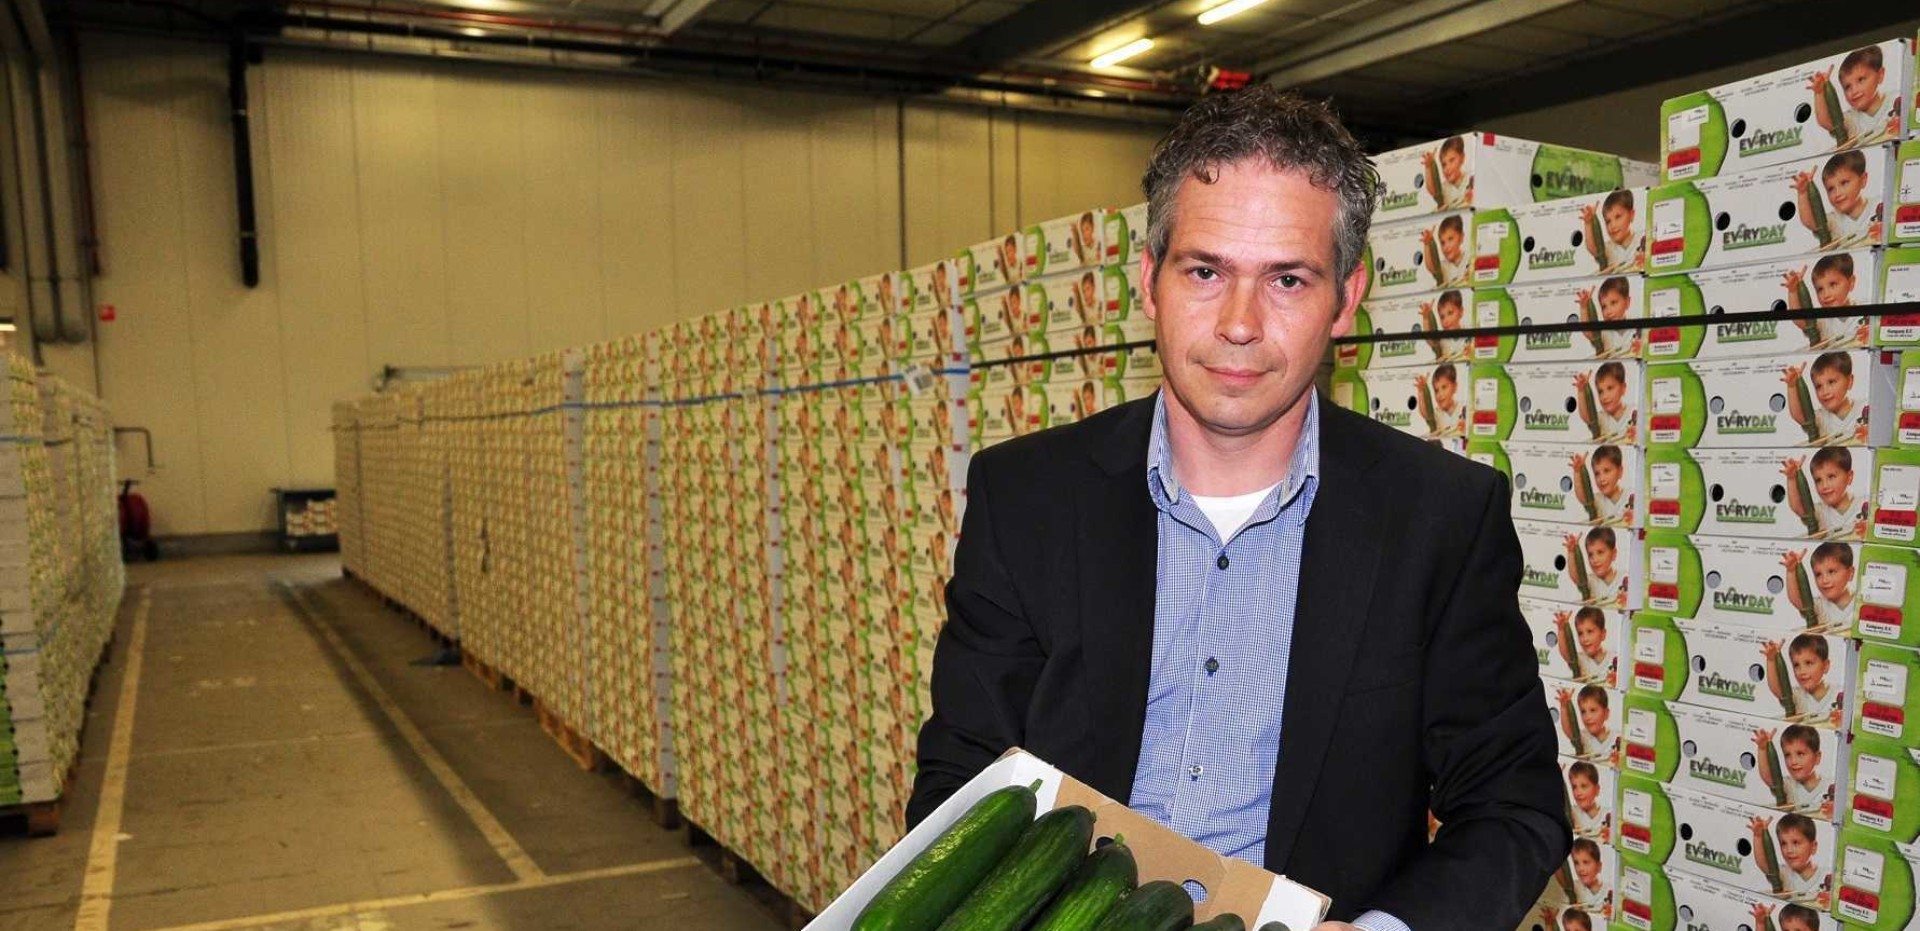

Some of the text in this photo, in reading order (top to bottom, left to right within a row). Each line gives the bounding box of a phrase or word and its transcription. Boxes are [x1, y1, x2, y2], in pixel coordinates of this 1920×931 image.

[1723, 223, 1787, 244] EVERYDAY
[1717, 409, 1778, 428] EVERYDAY
[1716, 498, 1777, 518] EVERYDAY
[1713, 586, 1775, 608] EVERYDAY
[1699, 672, 1756, 696] EVERYDAY
[1689, 757, 1747, 785] EVERYDAY
[1685, 841, 1743, 870] EVERYDAY
